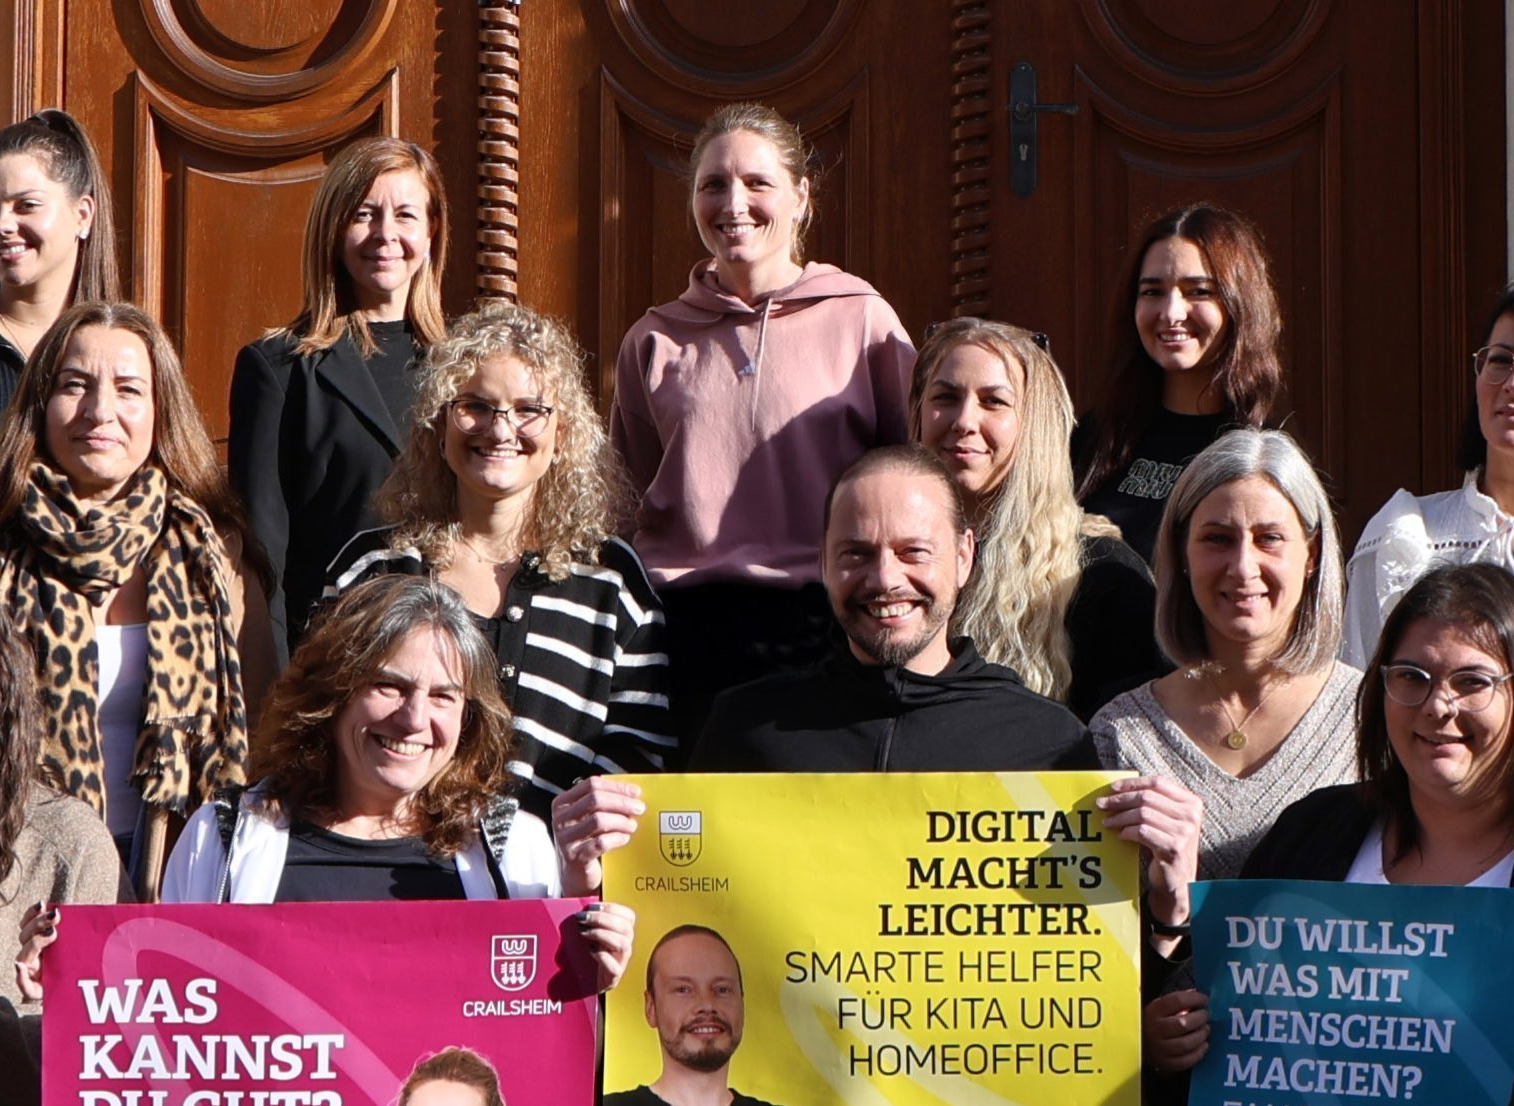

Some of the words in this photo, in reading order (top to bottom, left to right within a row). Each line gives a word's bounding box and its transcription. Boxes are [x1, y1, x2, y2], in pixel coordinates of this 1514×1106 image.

[925, 811, 1102, 843] DIGITAL
[635, 876, 729, 892] CRAILSHEIM
[878, 904, 1102, 937] LEICHTER.
[1225, 916, 1286, 950] DU
[1293, 917, 1454, 957] WILLST
[785, 951, 944, 983] SMARTE
[959, 950, 1101, 982] HELFER
[1227, 961, 1319, 998] WAS
[1327, 966, 1409, 1003] MIT
[77, 978, 218, 1024] WAS
[463, 999, 562, 1017] CRAILSHEIM
[838, 990, 912, 1030] FÜR
[927, 997, 1007, 1029] KITA
[1021, 997, 1101, 1029] UND
[1228, 1007, 1456, 1053] MENSCHEN
[79, 1034, 344, 1081] KANNST
[850, 1043, 1102, 1076] HOMEOFFICE.
[1223, 1054, 1422, 1100] MACHEN?
